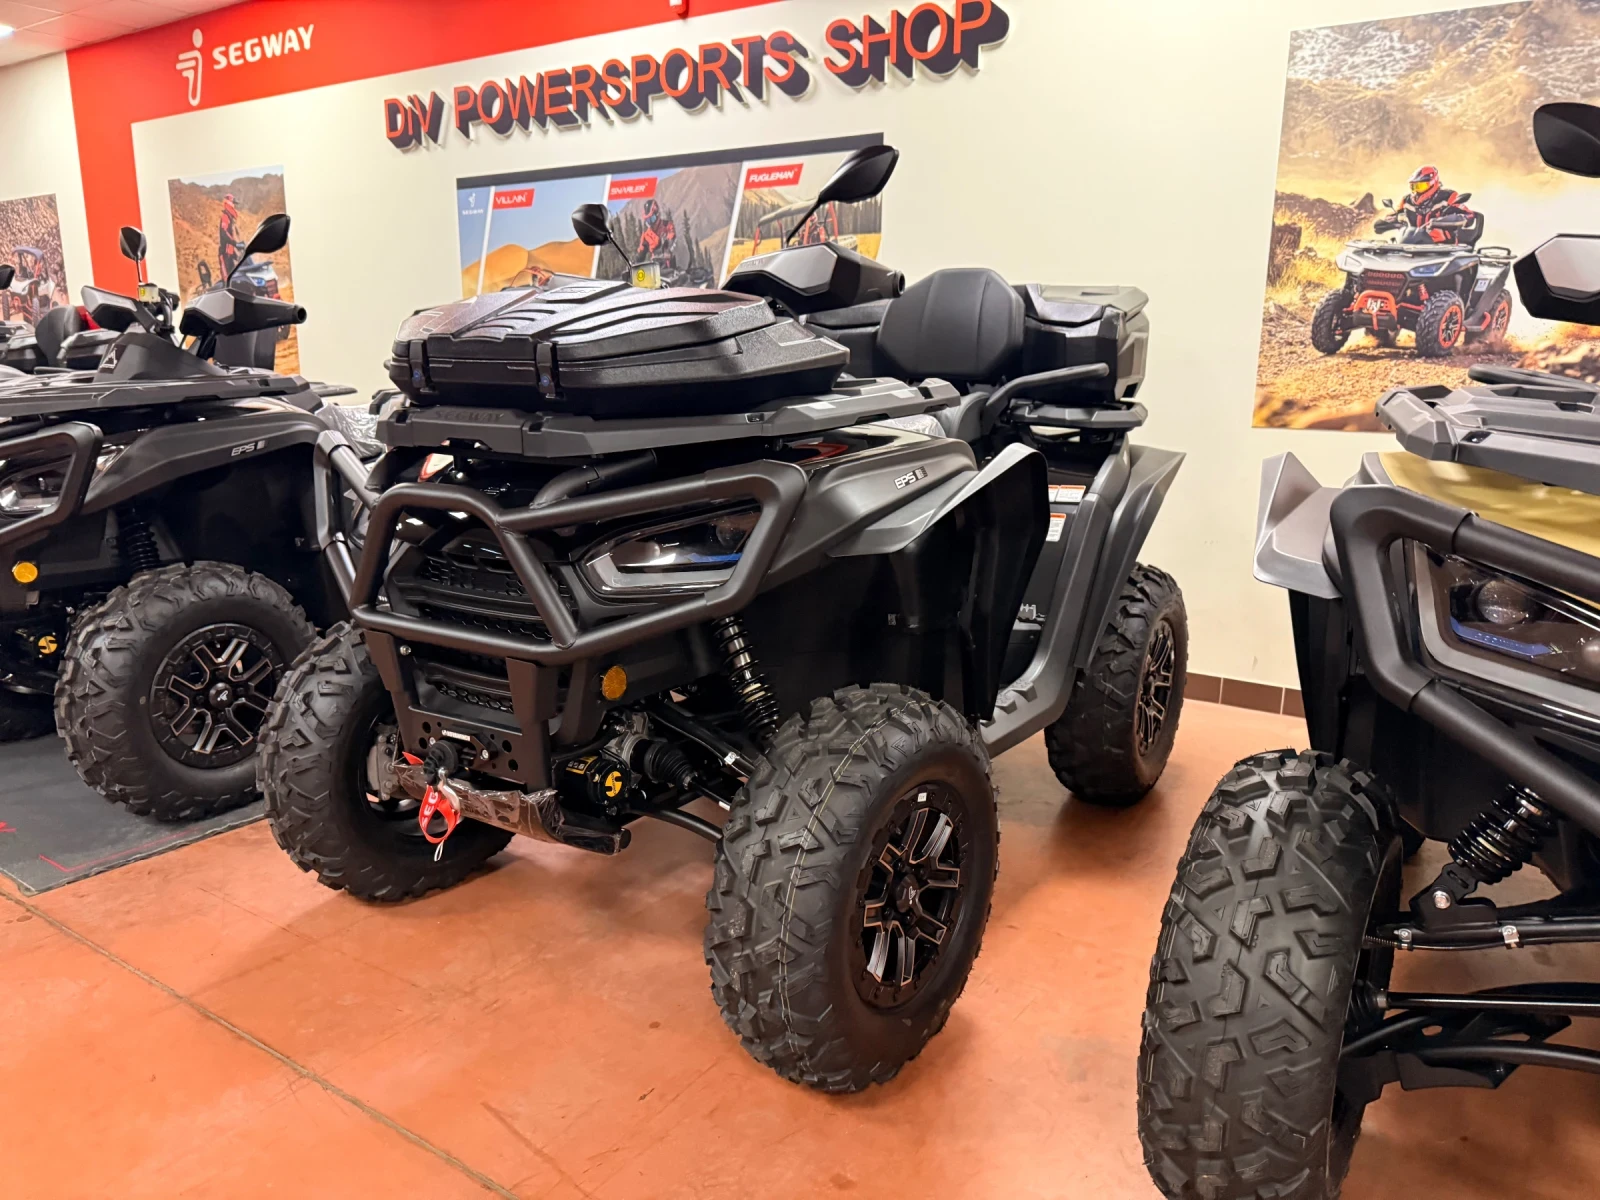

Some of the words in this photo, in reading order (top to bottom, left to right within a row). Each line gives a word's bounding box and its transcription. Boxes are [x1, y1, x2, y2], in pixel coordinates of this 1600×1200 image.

[212, 24, 315, 70] SEGWAY
[454, 29, 804, 137] POWERSPORTS
[823, 0, 1005, 87] SHOP
[749, 169, 795, 183] FUGLEMAN
[495, 193, 527, 205] VILLAIN
[231, 442, 256, 457] EPS
[894, 471, 916, 489] EPS
